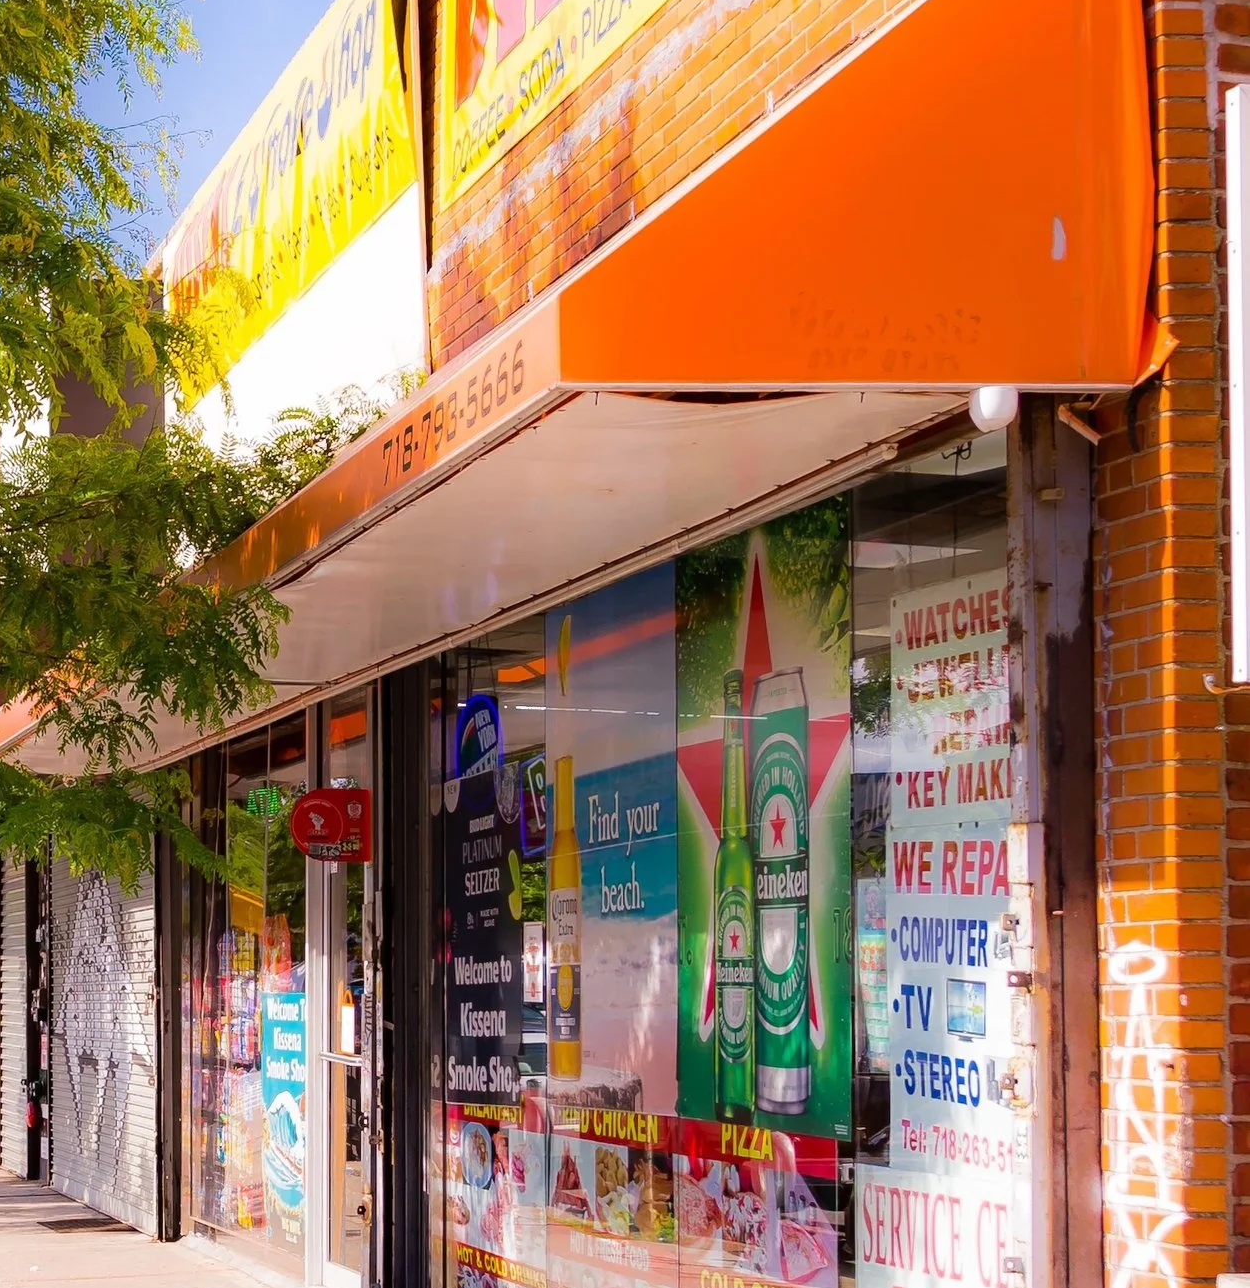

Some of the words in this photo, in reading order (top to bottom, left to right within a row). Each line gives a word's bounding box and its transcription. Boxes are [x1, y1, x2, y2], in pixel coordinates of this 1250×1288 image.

[451, 94, 506, 182] COFFEE
[518, 35, 566, 117] SODA
[382, 339, 525, 487] 718-793-5666
[907, 765, 951, 810] KEY
[588, 790, 620, 844] Find
[625, 801, 660, 857] your
[462, 834, 503, 865] PLATINUM
[893, 840, 934, 895] WE
[464, 867, 500, 897] SELTZER
[600, 861, 645, 914] beach.
[754, 860, 809, 901] eineken
[551, 893, 578, 923] Corona
[899, 915, 989, 968] COMPUTER
[453, 955, 499, 986] Welcome
[499, 954, 513, 983] to
[266, 996, 300, 1022] Welcome
[459, 1001, 507, 1038] Kissena
[900, 983, 933, 1032] TV
[273, 1026, 303, 1052] Kissena
[265, 1055, 291, 1081] Smoke
[447, 1054, 488, 1093] Smoke
[488, 1055, 520, 1103] Shop
[902, 1048, 981, 1108] STEREO
[592, 1109, 659, 1145] CHICKEN
[720, 1122, 774, 1161] PIZZA
[900, 1118, 928, 1155] Tel:
[862, 1182, 963, 1281] SERVICE
[456, 1244, 475, 1263] HOT
[476, 1249, 484, 1269] &
[484, 1254, 508, 1277] COLD
